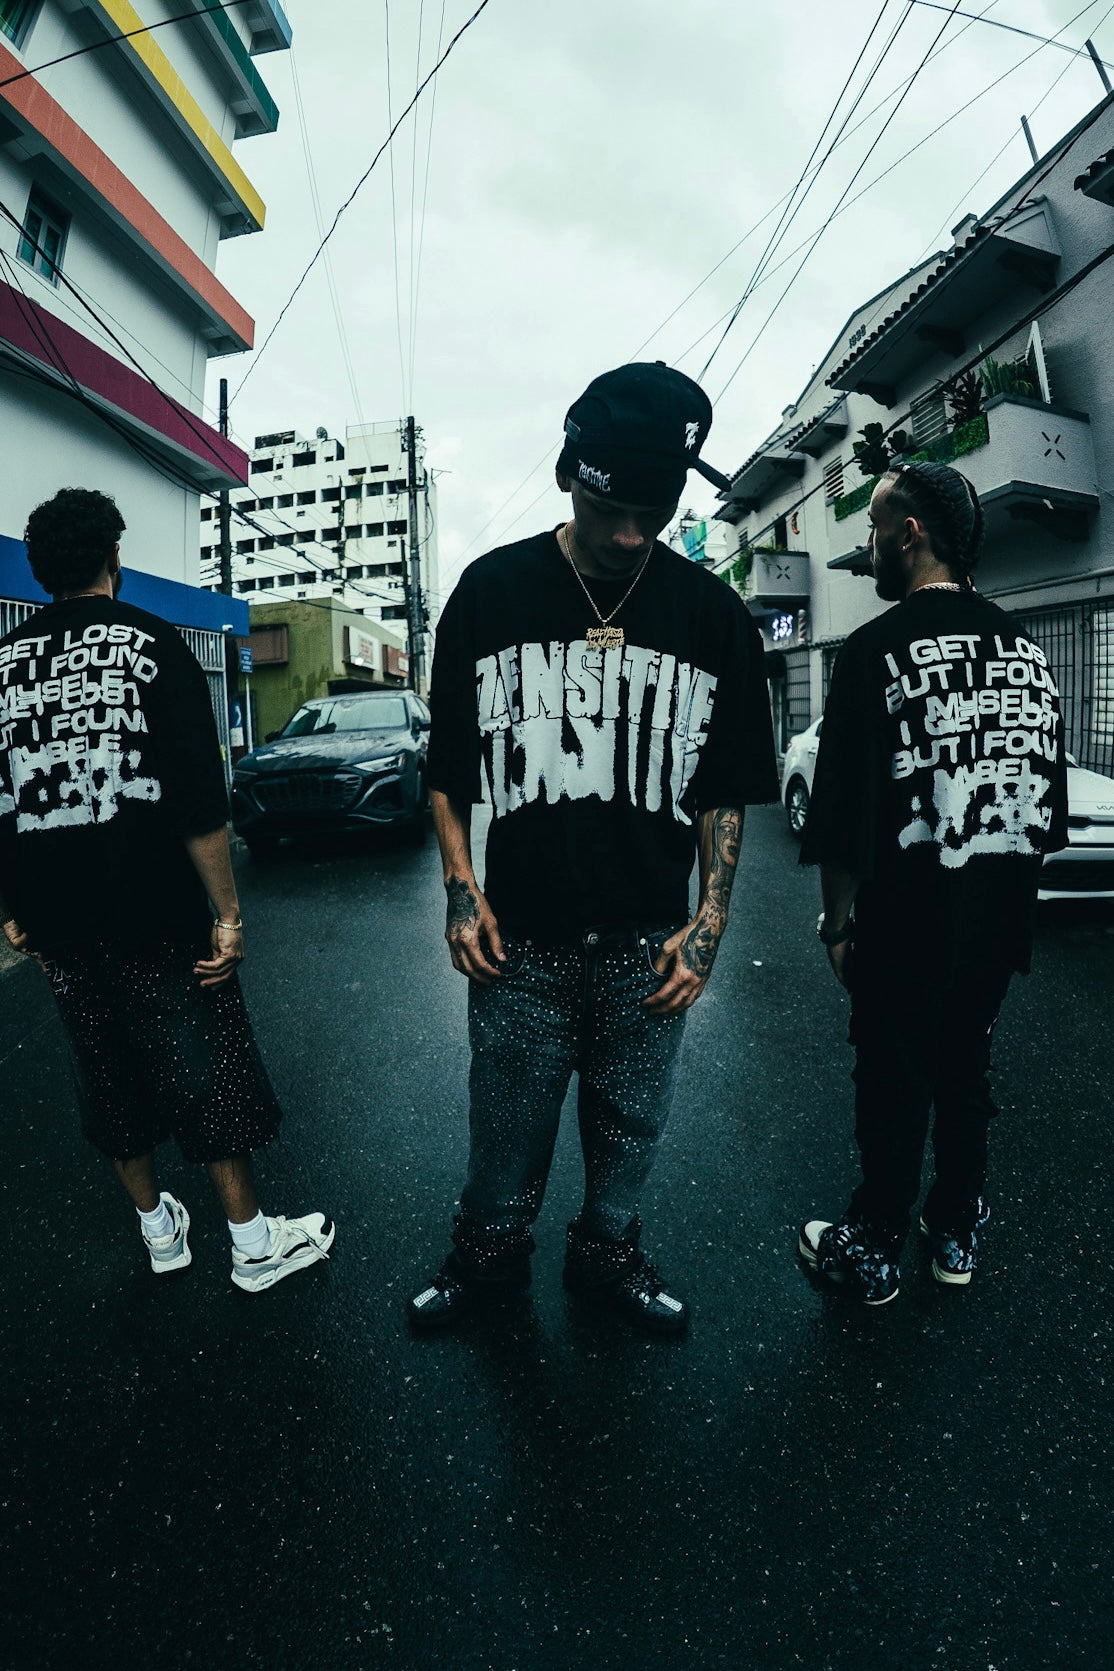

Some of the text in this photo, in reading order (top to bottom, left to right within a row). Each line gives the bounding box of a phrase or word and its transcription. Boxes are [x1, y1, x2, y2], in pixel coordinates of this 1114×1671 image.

[64, 624, 155, 651] LOST
[885, 635, 1048, 678] I GET LOS
[28, 659, 37, 681] I
[50, 645, 158, 683] FOUND
[885, 660, 1059, 715] BUT I FOUN
[31, 719, 40, 741] I
[900, 720, 911, 746] I
[891, 736, 961, 780] BUT
[970, 733, 976, 759] I
